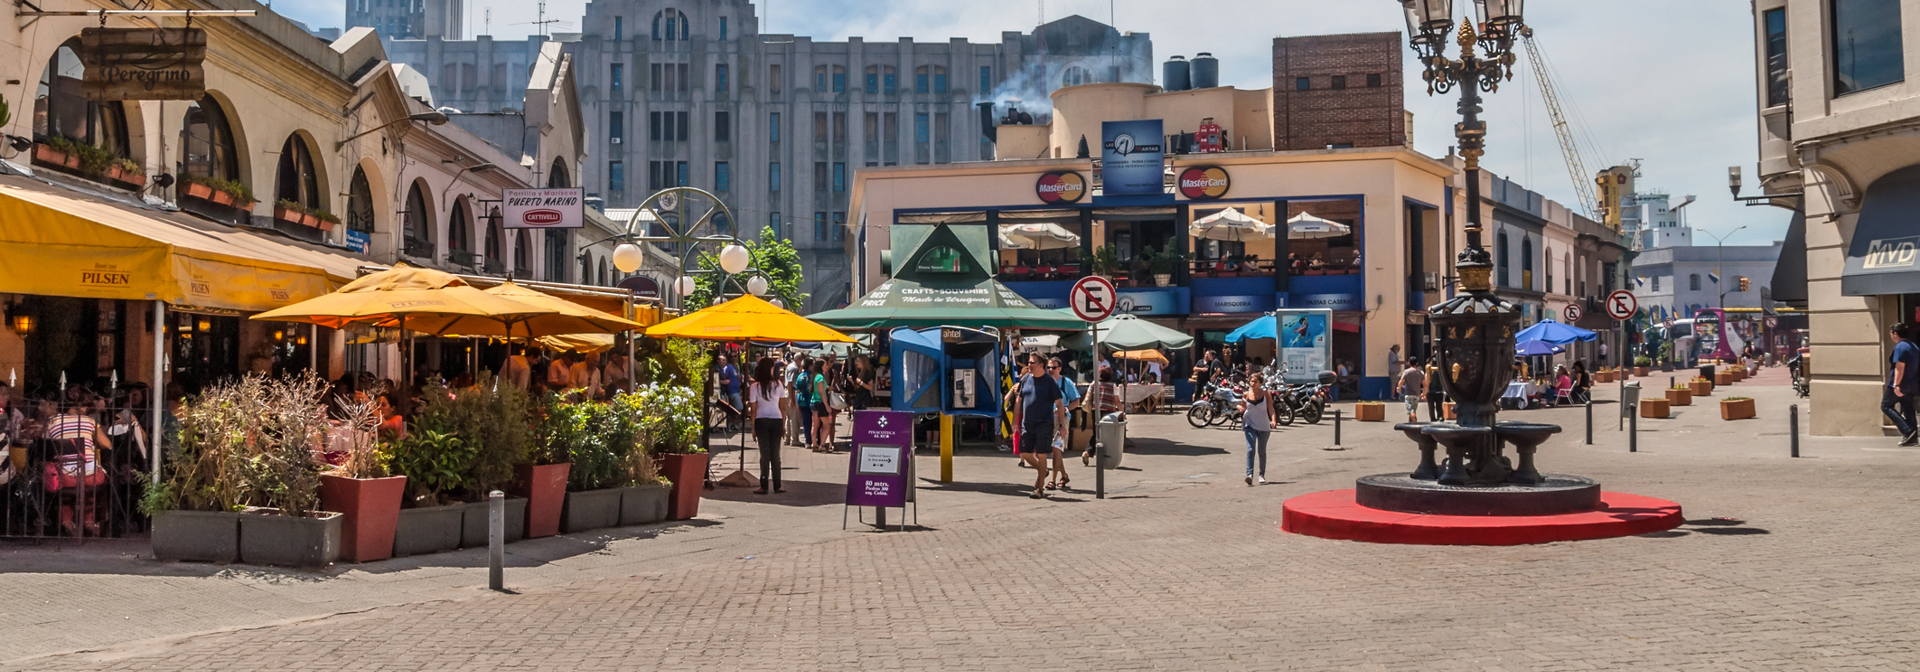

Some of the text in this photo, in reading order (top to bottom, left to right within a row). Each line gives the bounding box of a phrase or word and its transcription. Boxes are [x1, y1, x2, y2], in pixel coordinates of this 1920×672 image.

[101, 65, 190, 91] Peregrino
[1039, 183, 1082, 192] MasterCard
[1182, 178, 1226, 188] MasterCard
[508, 197, 577, 206] PUERTO MARINO
[1864, 240, 1915, 267] MVD
[82, 272, 130, 284] PILSEN
[191, 282, 210, 294] PILSEN
[270, 290, 289, 300] PILSEN
[944, 296, 991, 304] Uruguay
[1086, 287, 1102, 312] E
[1616, 297, 1627, 313] E
[1569, 308, 1577, 318] E
[943, 329, 961, 338] antel
